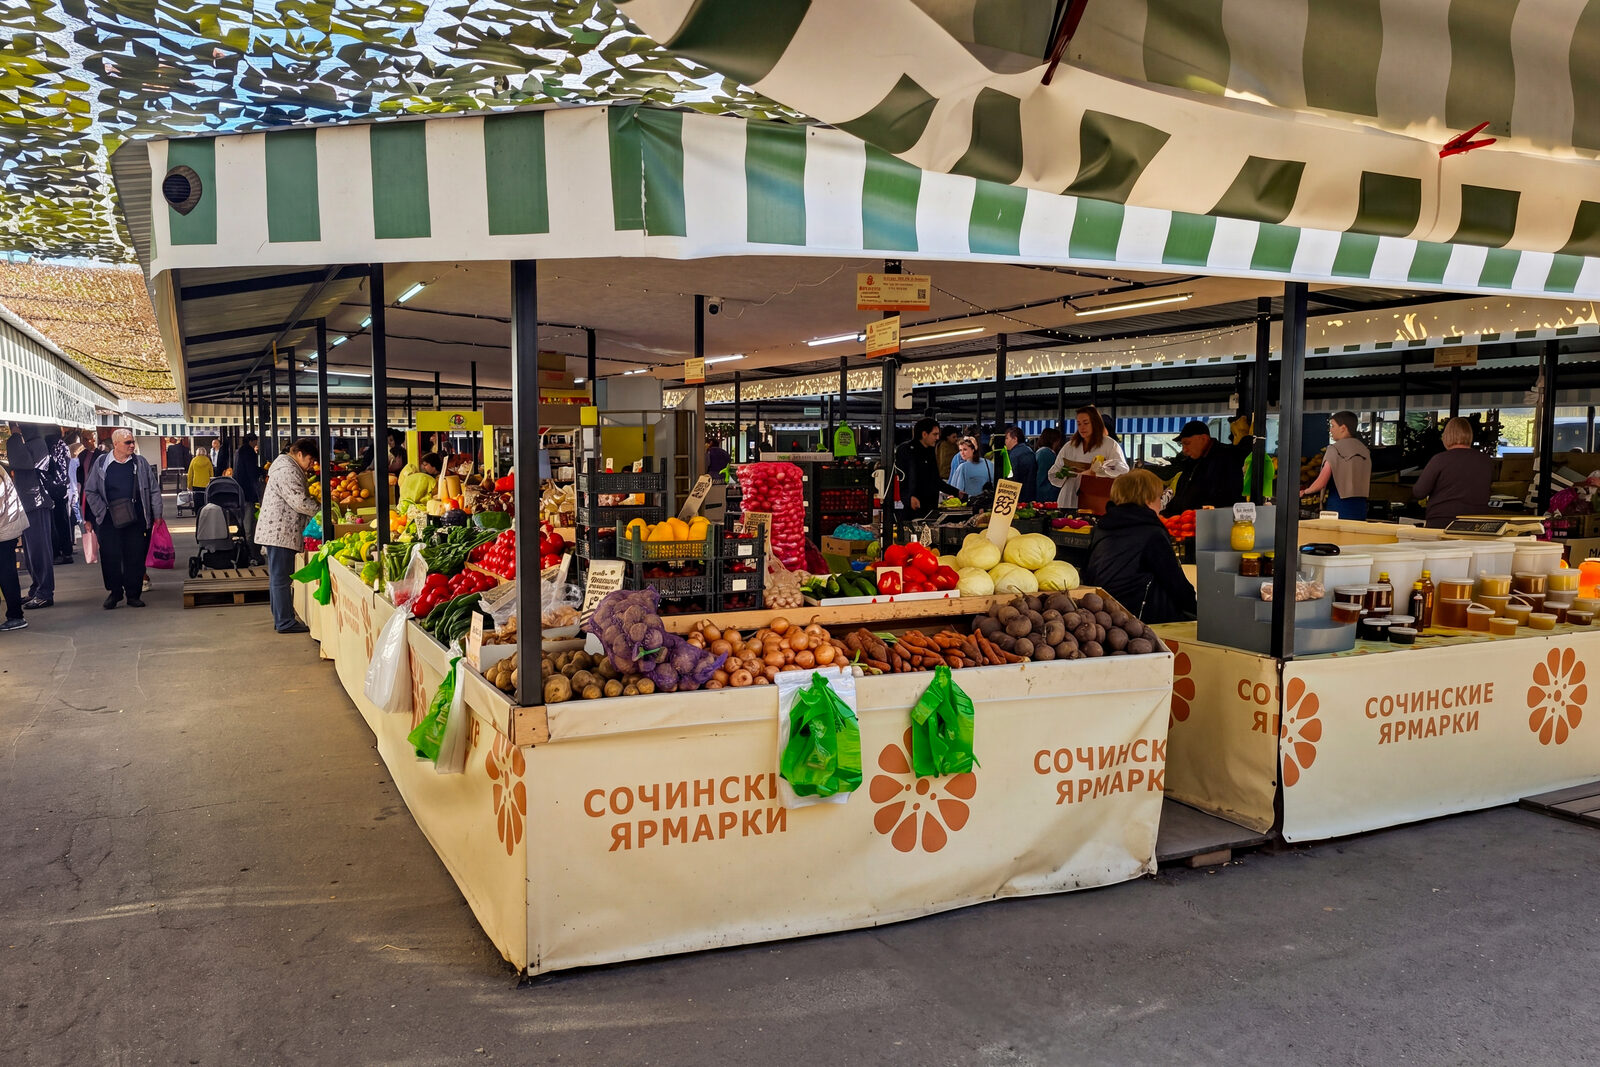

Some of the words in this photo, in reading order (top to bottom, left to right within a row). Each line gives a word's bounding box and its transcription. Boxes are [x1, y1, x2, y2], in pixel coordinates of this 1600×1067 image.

[1365, 682, 1494, 719] СОЧИНСКИЕ
[1378, 710, 1479, 745] ЯРМАРКИ
[608, 806, 788, 852] ЯРМАРКИ
